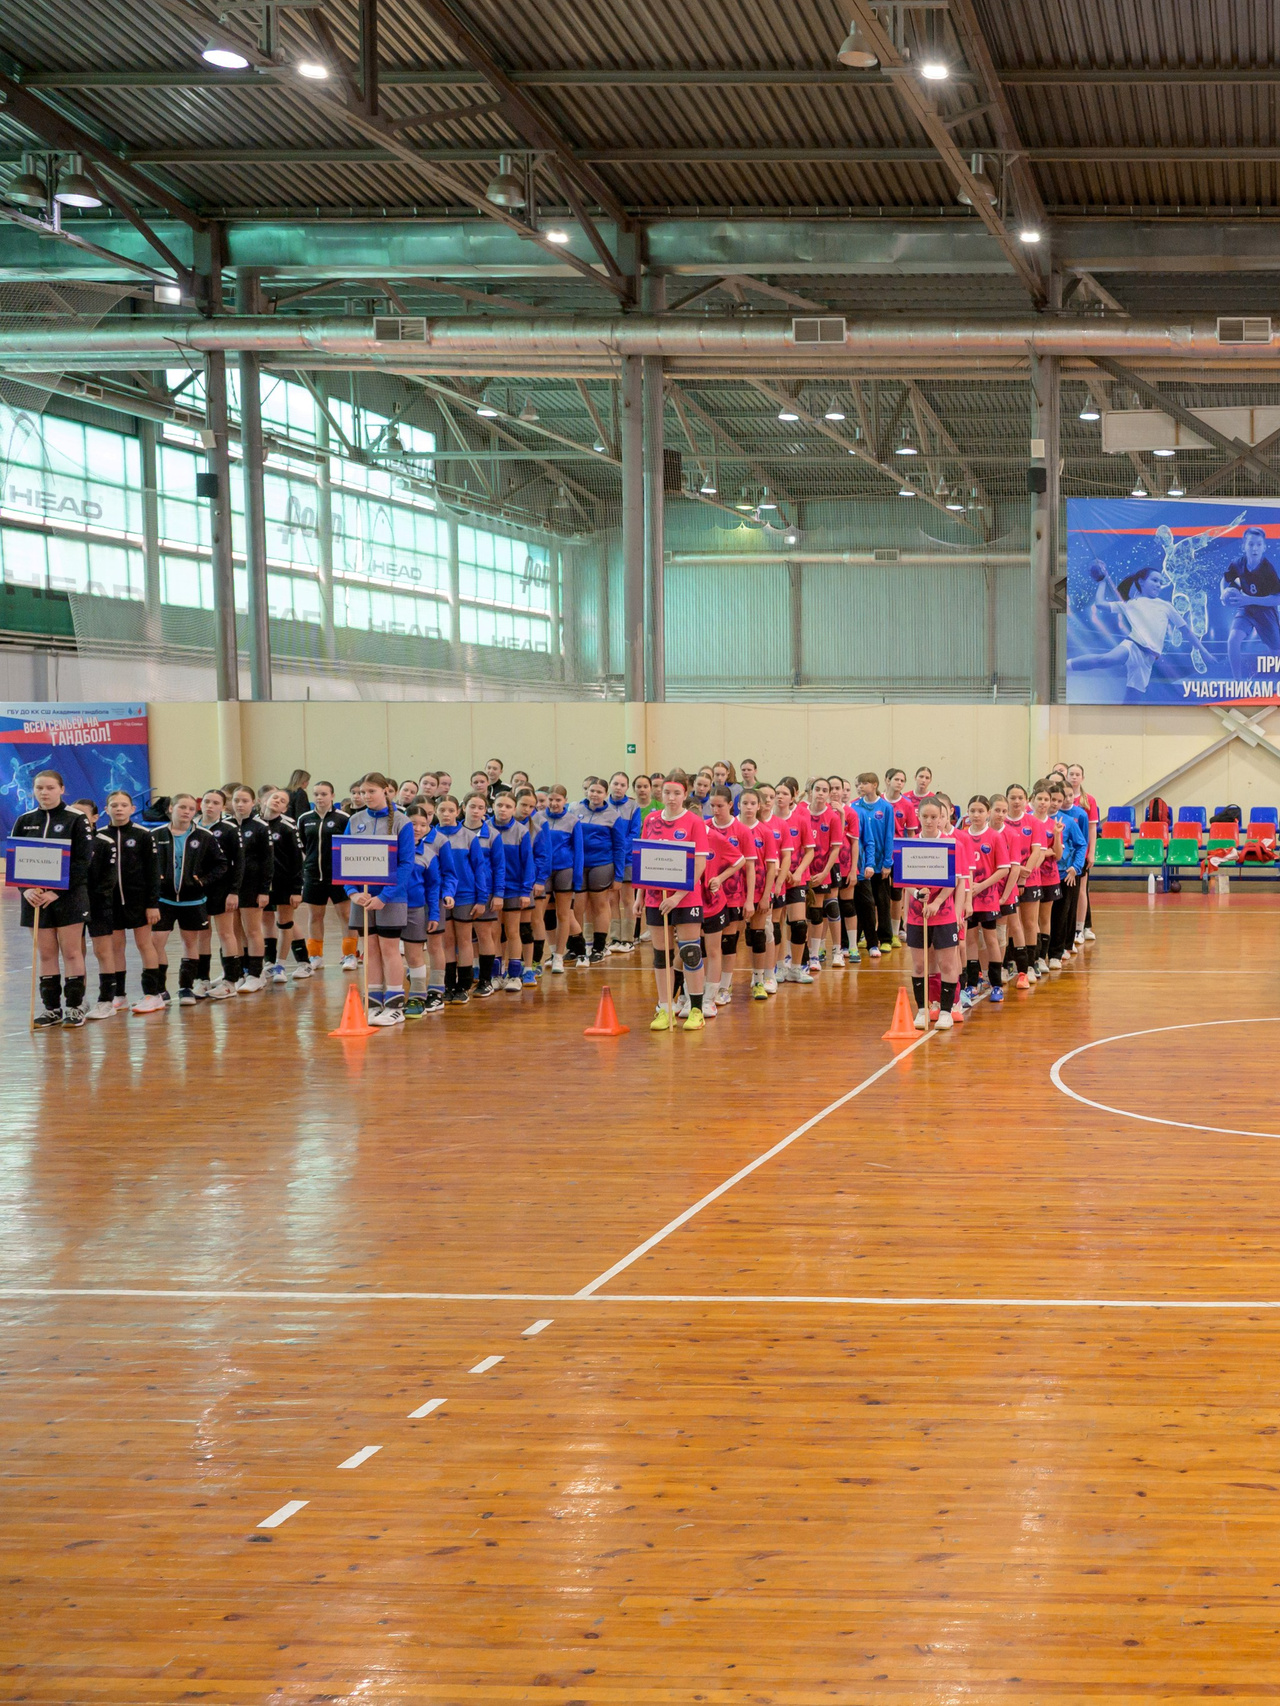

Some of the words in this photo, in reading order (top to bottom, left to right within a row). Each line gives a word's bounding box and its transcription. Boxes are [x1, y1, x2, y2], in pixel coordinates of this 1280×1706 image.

[9, 484, 103, 520] HEAD
[372, 559, 422, 581] HEAD
[1250, 583, 1258, 594] 8
[1183, 680, 1274, 698] УЧАСТНИКАМ
[23, 717, 47, 733] ВСЕЙ
[86, 716, 99, 728] НА
[690, 907, 700, 917] 43
[952, 933, 958, 942] 8
